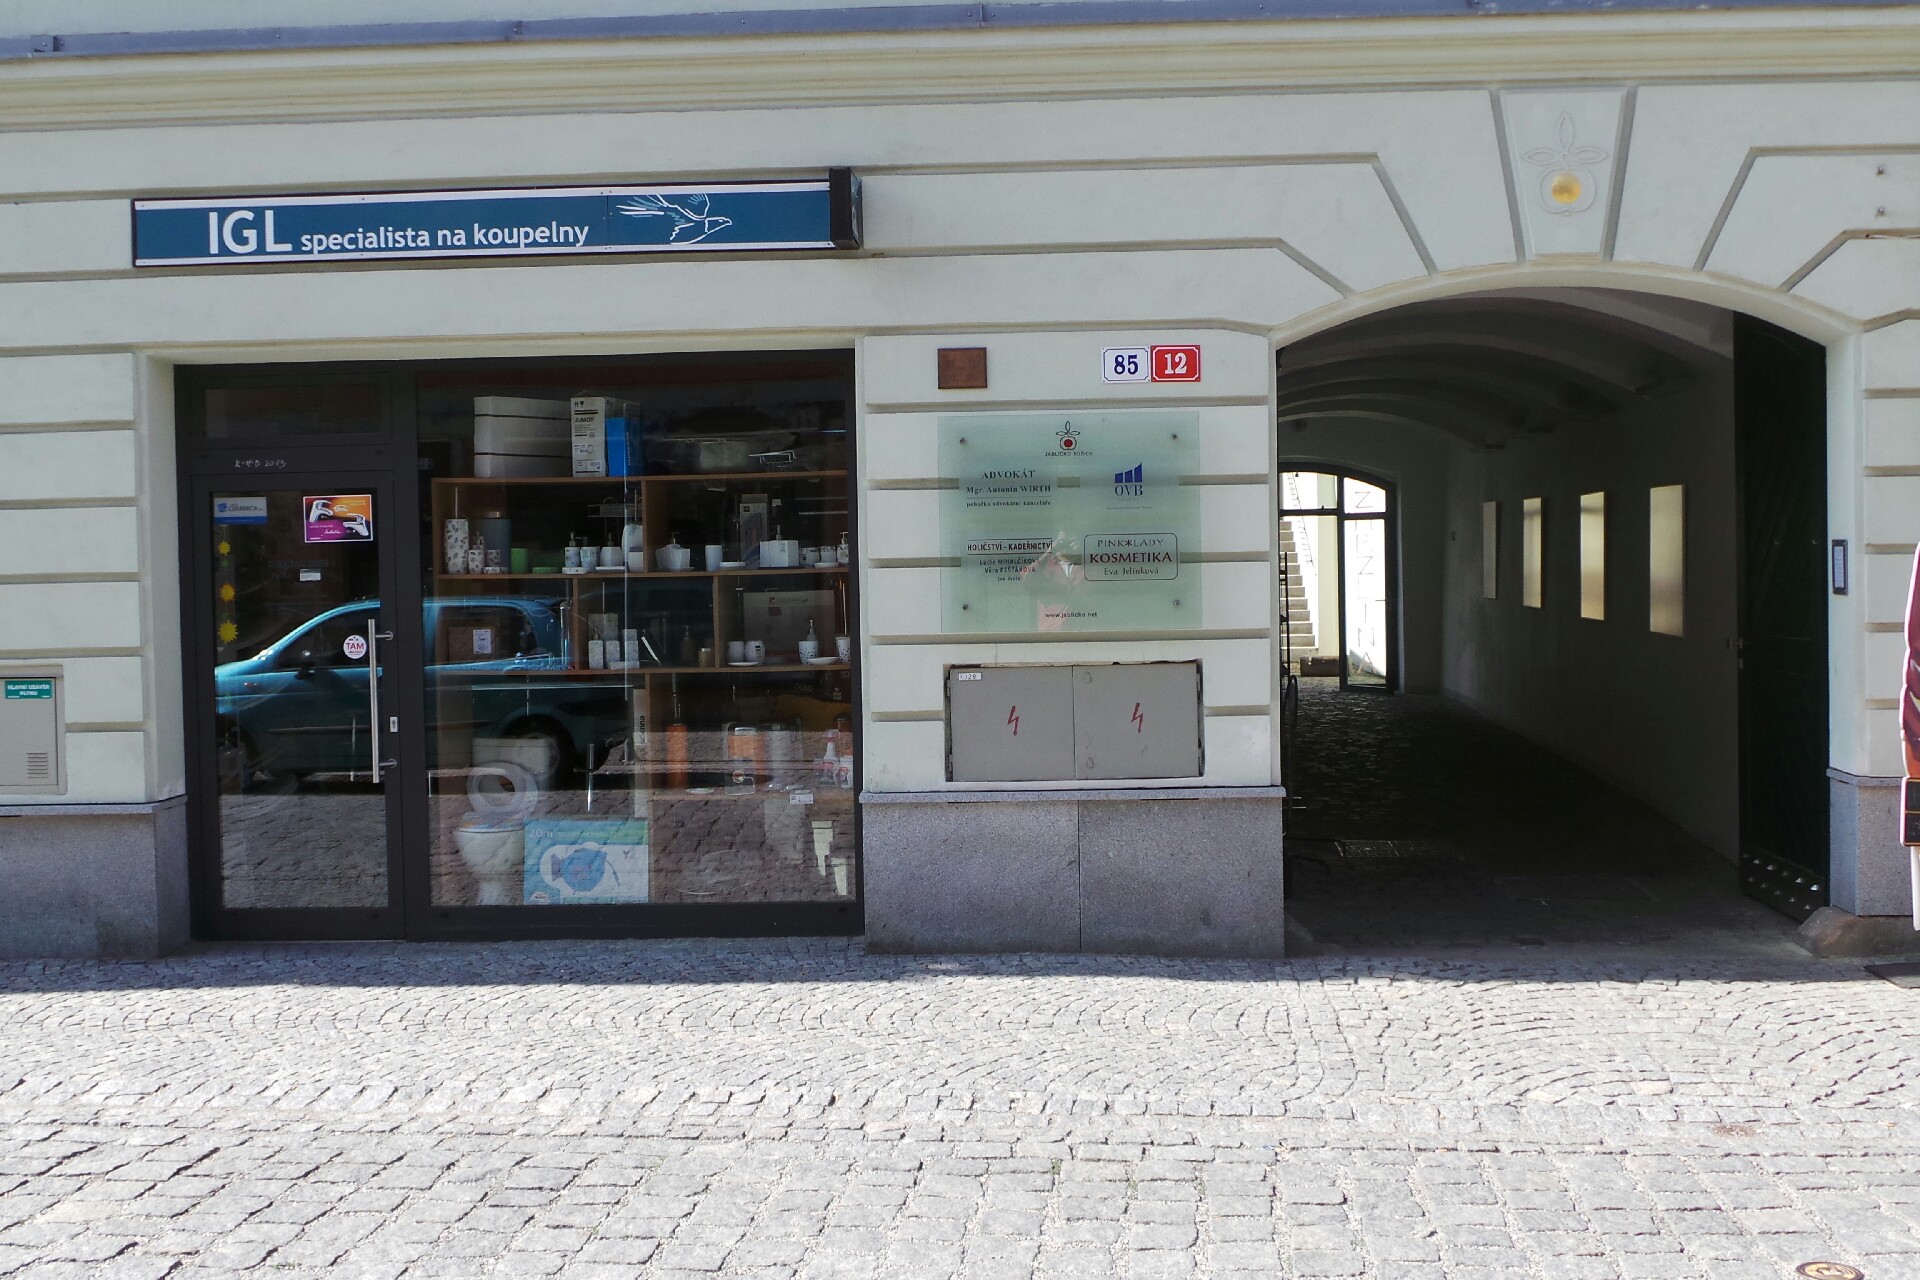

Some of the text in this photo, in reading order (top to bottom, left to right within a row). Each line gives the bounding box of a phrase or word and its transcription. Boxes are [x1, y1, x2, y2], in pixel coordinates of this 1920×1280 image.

[208, 209, 589, 255] IGL specialista na koupelny
[1113, 354, 1139, 375] 85
[1164, 352, 1188, 375] 12
[981, 468, 1036, 479] ADVOKÁT
[1020, 485, 1051, 493] WIRTH
[1114, 484, 1143, 497] OVB
[967, 541, 1002, 551] HOLIČSTVÍ
[997, 556, 1041, 565] MIHALČÍKOV
[1089, 552, 1173, 564] KOSMETIKA
[1104, 567, 1118, 575] Eva
[345, 642, 365, 650] TAM
